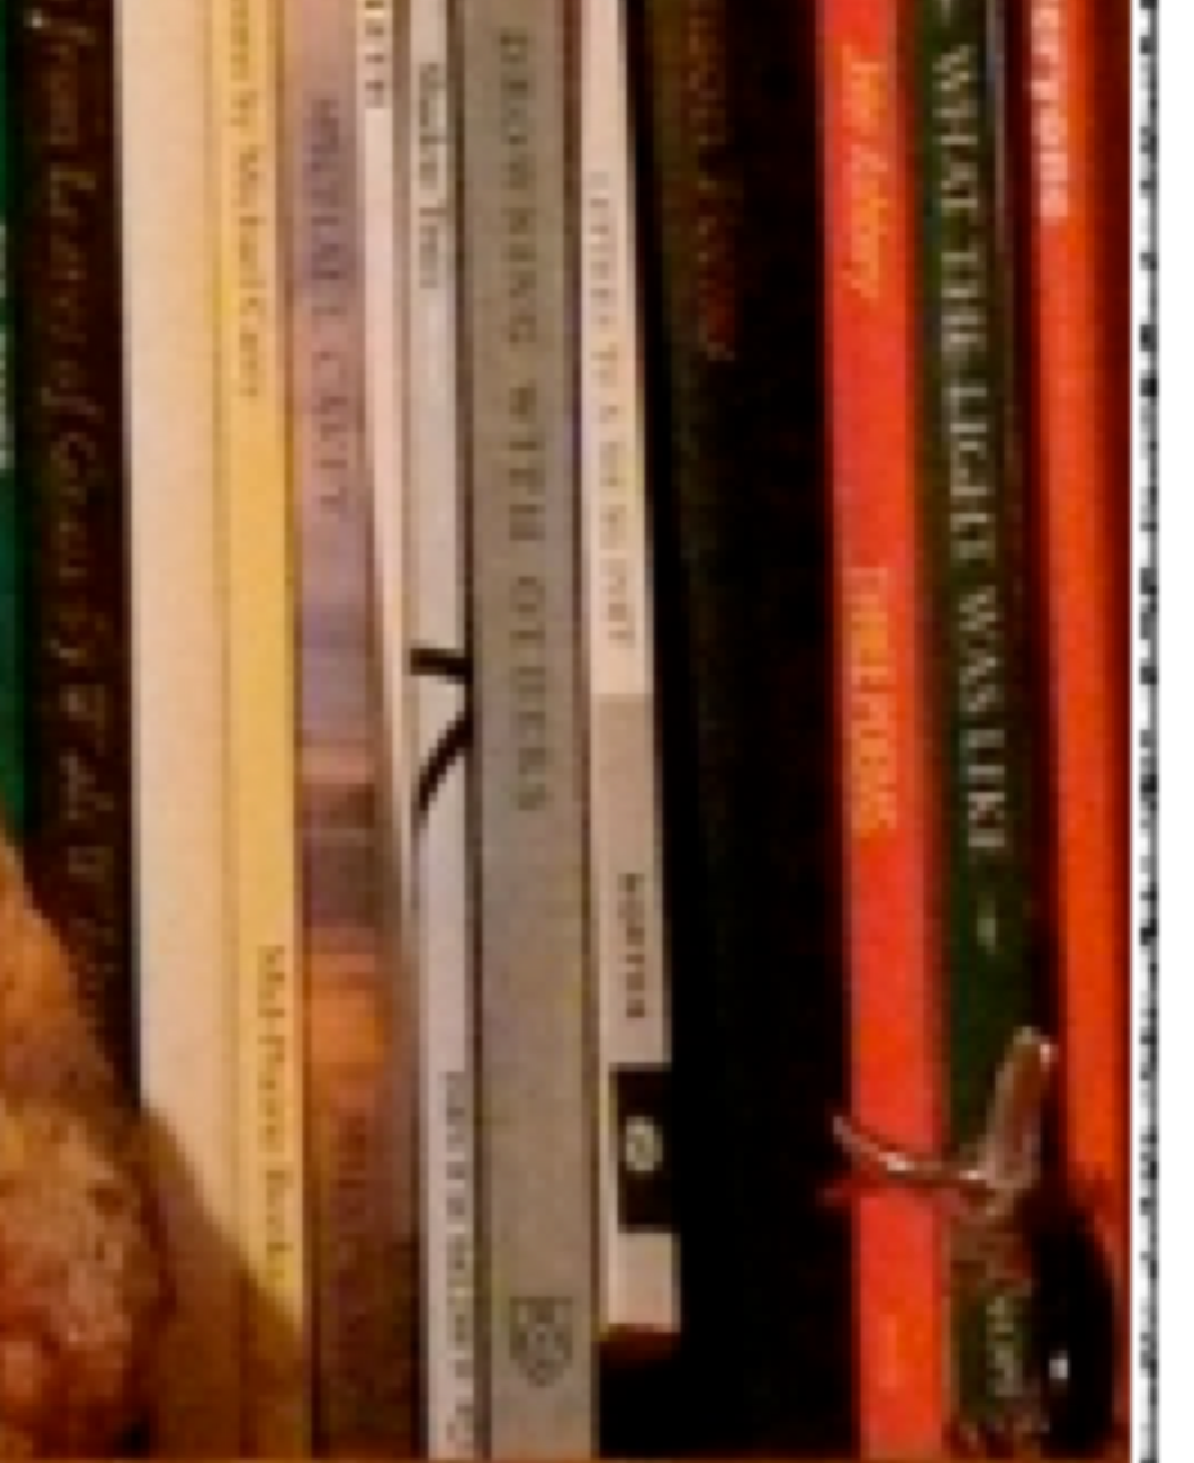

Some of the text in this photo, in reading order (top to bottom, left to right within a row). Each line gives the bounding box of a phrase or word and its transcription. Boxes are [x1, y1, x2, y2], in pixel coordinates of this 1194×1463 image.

[228, 88, 260, 133] by
[932, 43, 981, 220] WHAT
[233, 143, 269, 286] Michael
[494, 30, 542, 347] DROWNING
[941, 248, 982, 366] THE
[506, 384, 544, 542] WITH
[945, 381, 997, 566] LIGHT
[511, 575, 549, 813] OTHERS
[956, 585, 1001, 713] WAS
[961, 726, 1008, 862] LIKE
